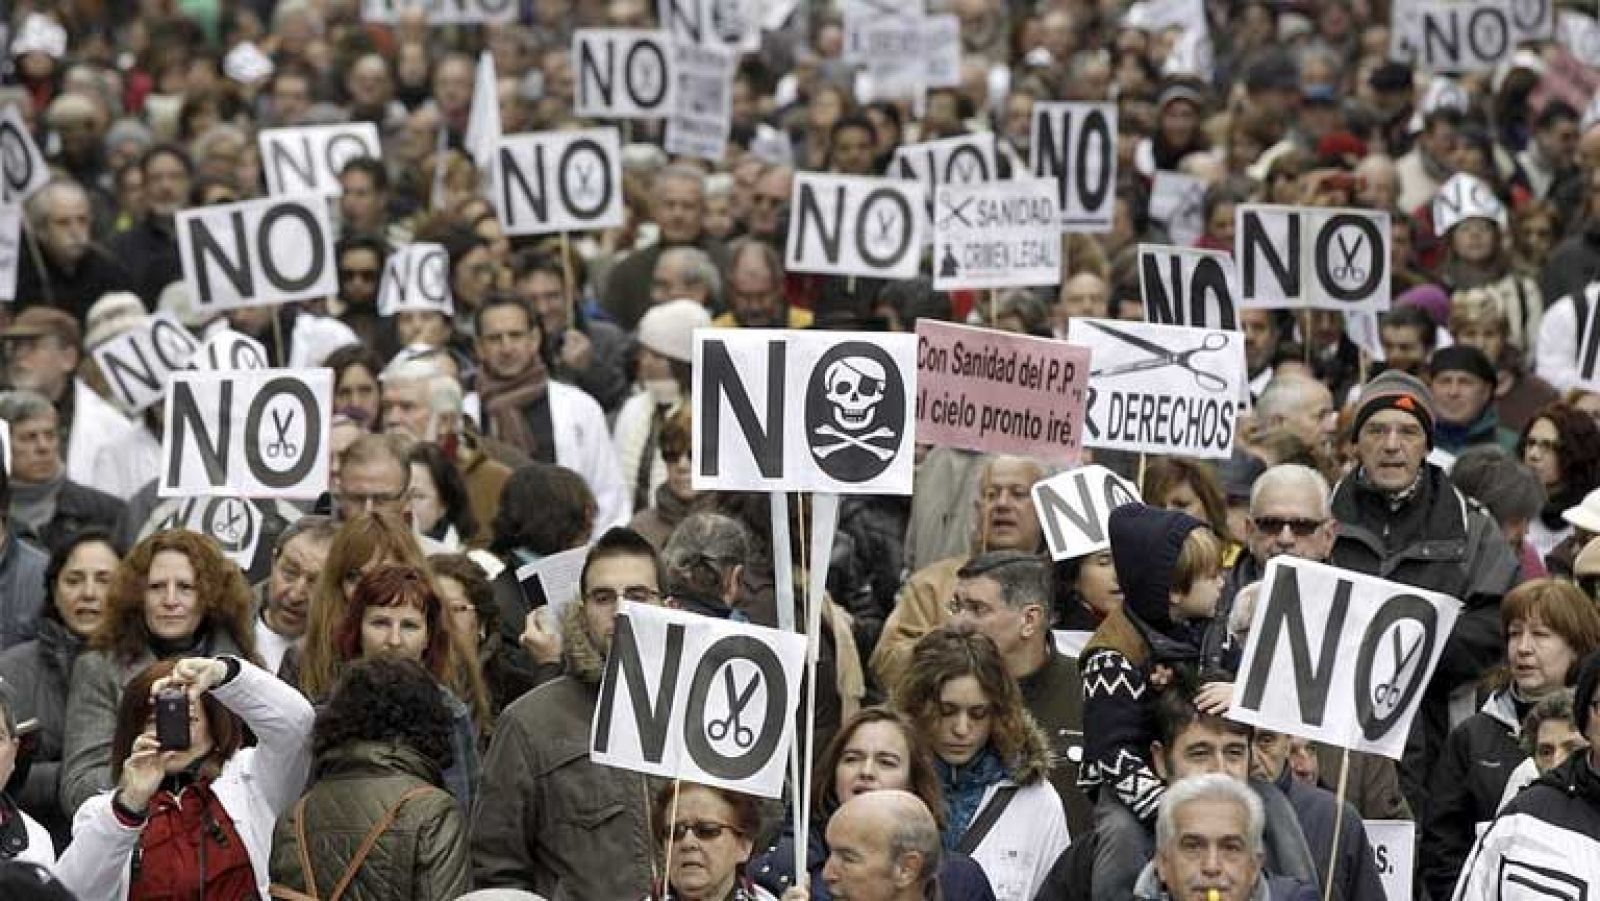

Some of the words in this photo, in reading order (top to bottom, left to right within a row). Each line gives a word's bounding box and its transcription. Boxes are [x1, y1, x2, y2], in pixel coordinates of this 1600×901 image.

[581, 39, 668, 107] NO
[1424, 7, 1508, 65] NO
[499, 139, 613, 226] NO
[1036, 109, 1111, 212] NO
[795, 183, 913, 268] NO
[977, 196, 1052, 227] SANIDAD
[189, 203, 325, 304] NO
[390, 250, 446, 303] NO
[964, 241, 1010, 269] CRIMEN
[1013, 239, 1056, 268] LEGAL
[1144, 252, 1235, 331] NO
[1243, 211, 1384, 302] NO
[103, 318, 197, 405] NO
[917, 335, 948, 373] Con
[951, 341, 1017, 385] Sanidad
[1019, 353, 1044, 390] del
[1047, 357, 1082, 403] P.P.,
[168, 376, 320, 489] NO
[701, 339, 906, 482] NO
[930, 392, 976, 428] cielo
[980, 404, 1042, 440] pronto
[1047, 409, 1076, 447] iré.
[1106, 391, 1234, 450] DERECHOS
[1240, 565, 1438, 741] NO
[594, 614, 788, 780] NO
